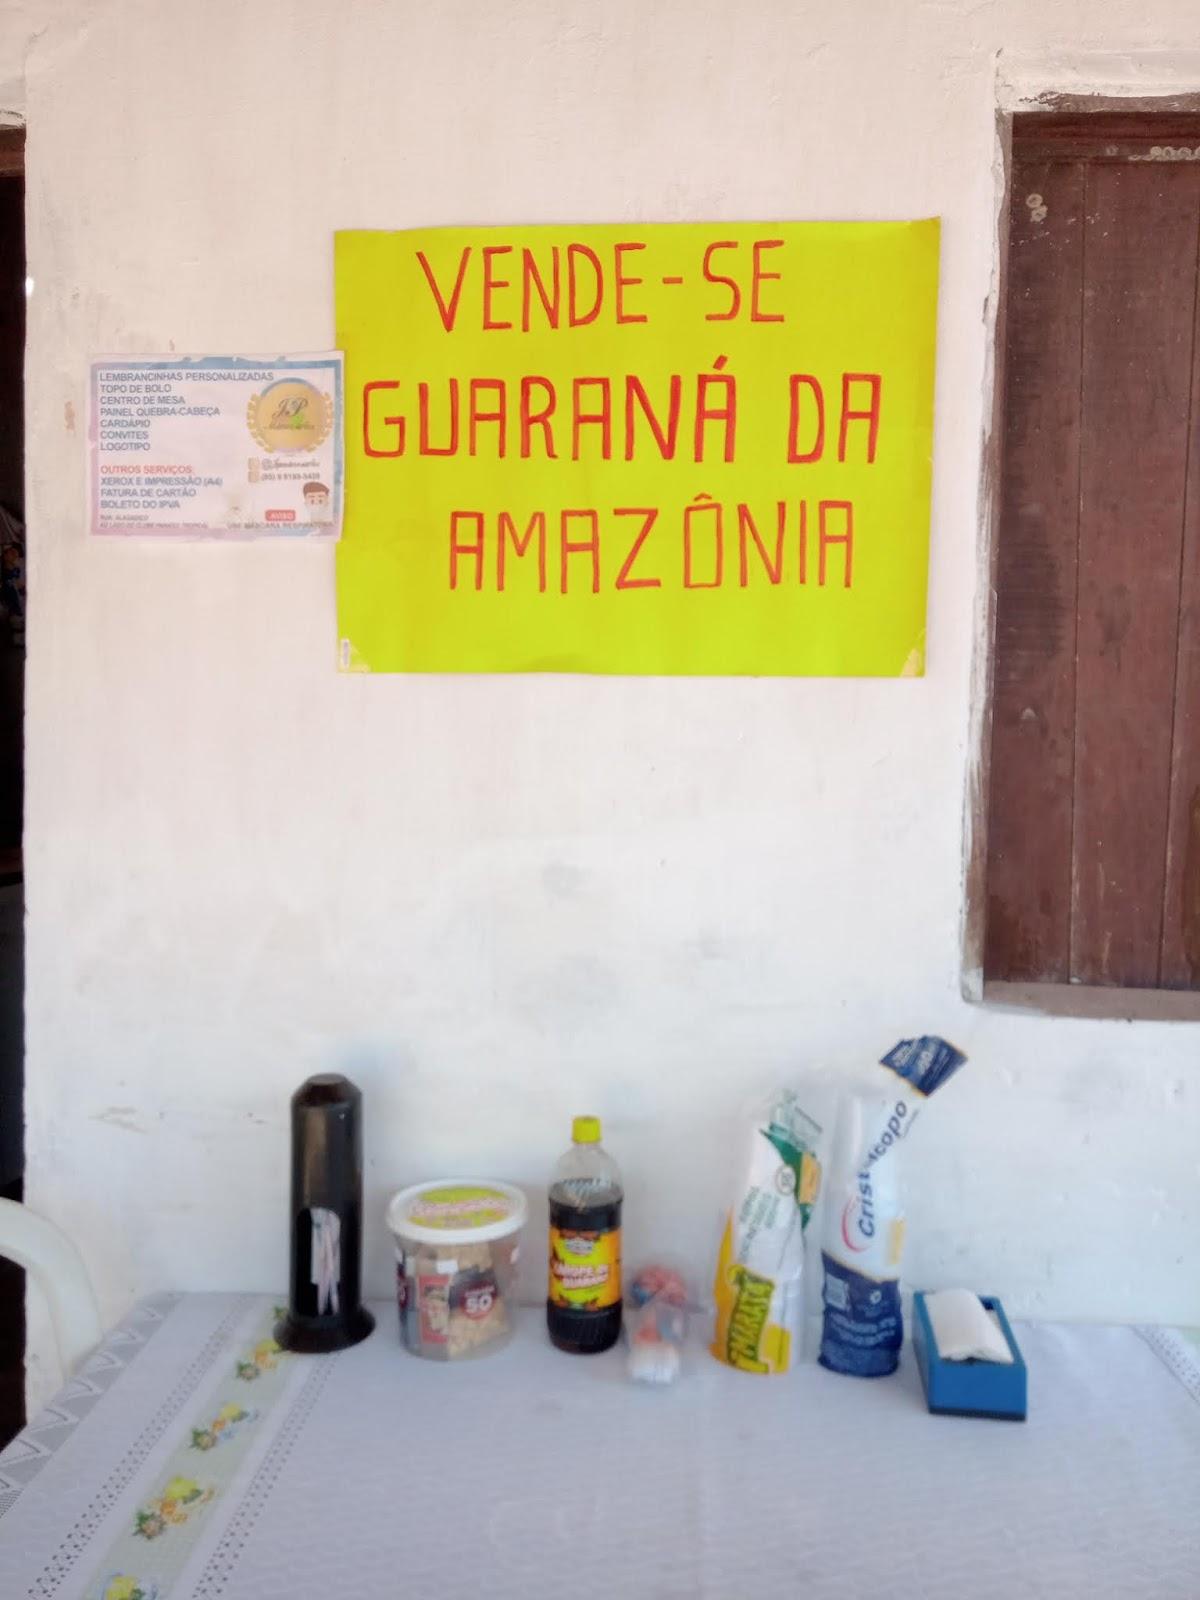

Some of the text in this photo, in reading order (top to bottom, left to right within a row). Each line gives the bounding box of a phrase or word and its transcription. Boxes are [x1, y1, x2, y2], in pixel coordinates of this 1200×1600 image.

[416, 241, 784, 331] VENDE-SE
[99, 371, 274, 382] LEMBRANCINHAS PERSONALIZADAS
[100, 383, 172, 394] TOPO DE BOLO
[100, 395, 185, 405] CENTRO DE MESA
[100, 407, 220, 418] PAINEL QUEBRA-CABEÇA
[364, 356, 880, 464] GUARANÁ DA
[100, 418, 151, 428] CARDÁPIO
[100, 430, 149, 440] CONVITES
[100, 441, 151, 451] LOGOTIPO
[100, 465, 142, 474] OUTROS
[100, 476, 223, 488] XEROX E IMPRESSÃO (A4)
[100, 487, 197, 498] FATURA DE CARTÃO
[100, 499, 180, 509] BOLETO DO IPVA
[451, 493, 851, 592] AMAZÔNIA
